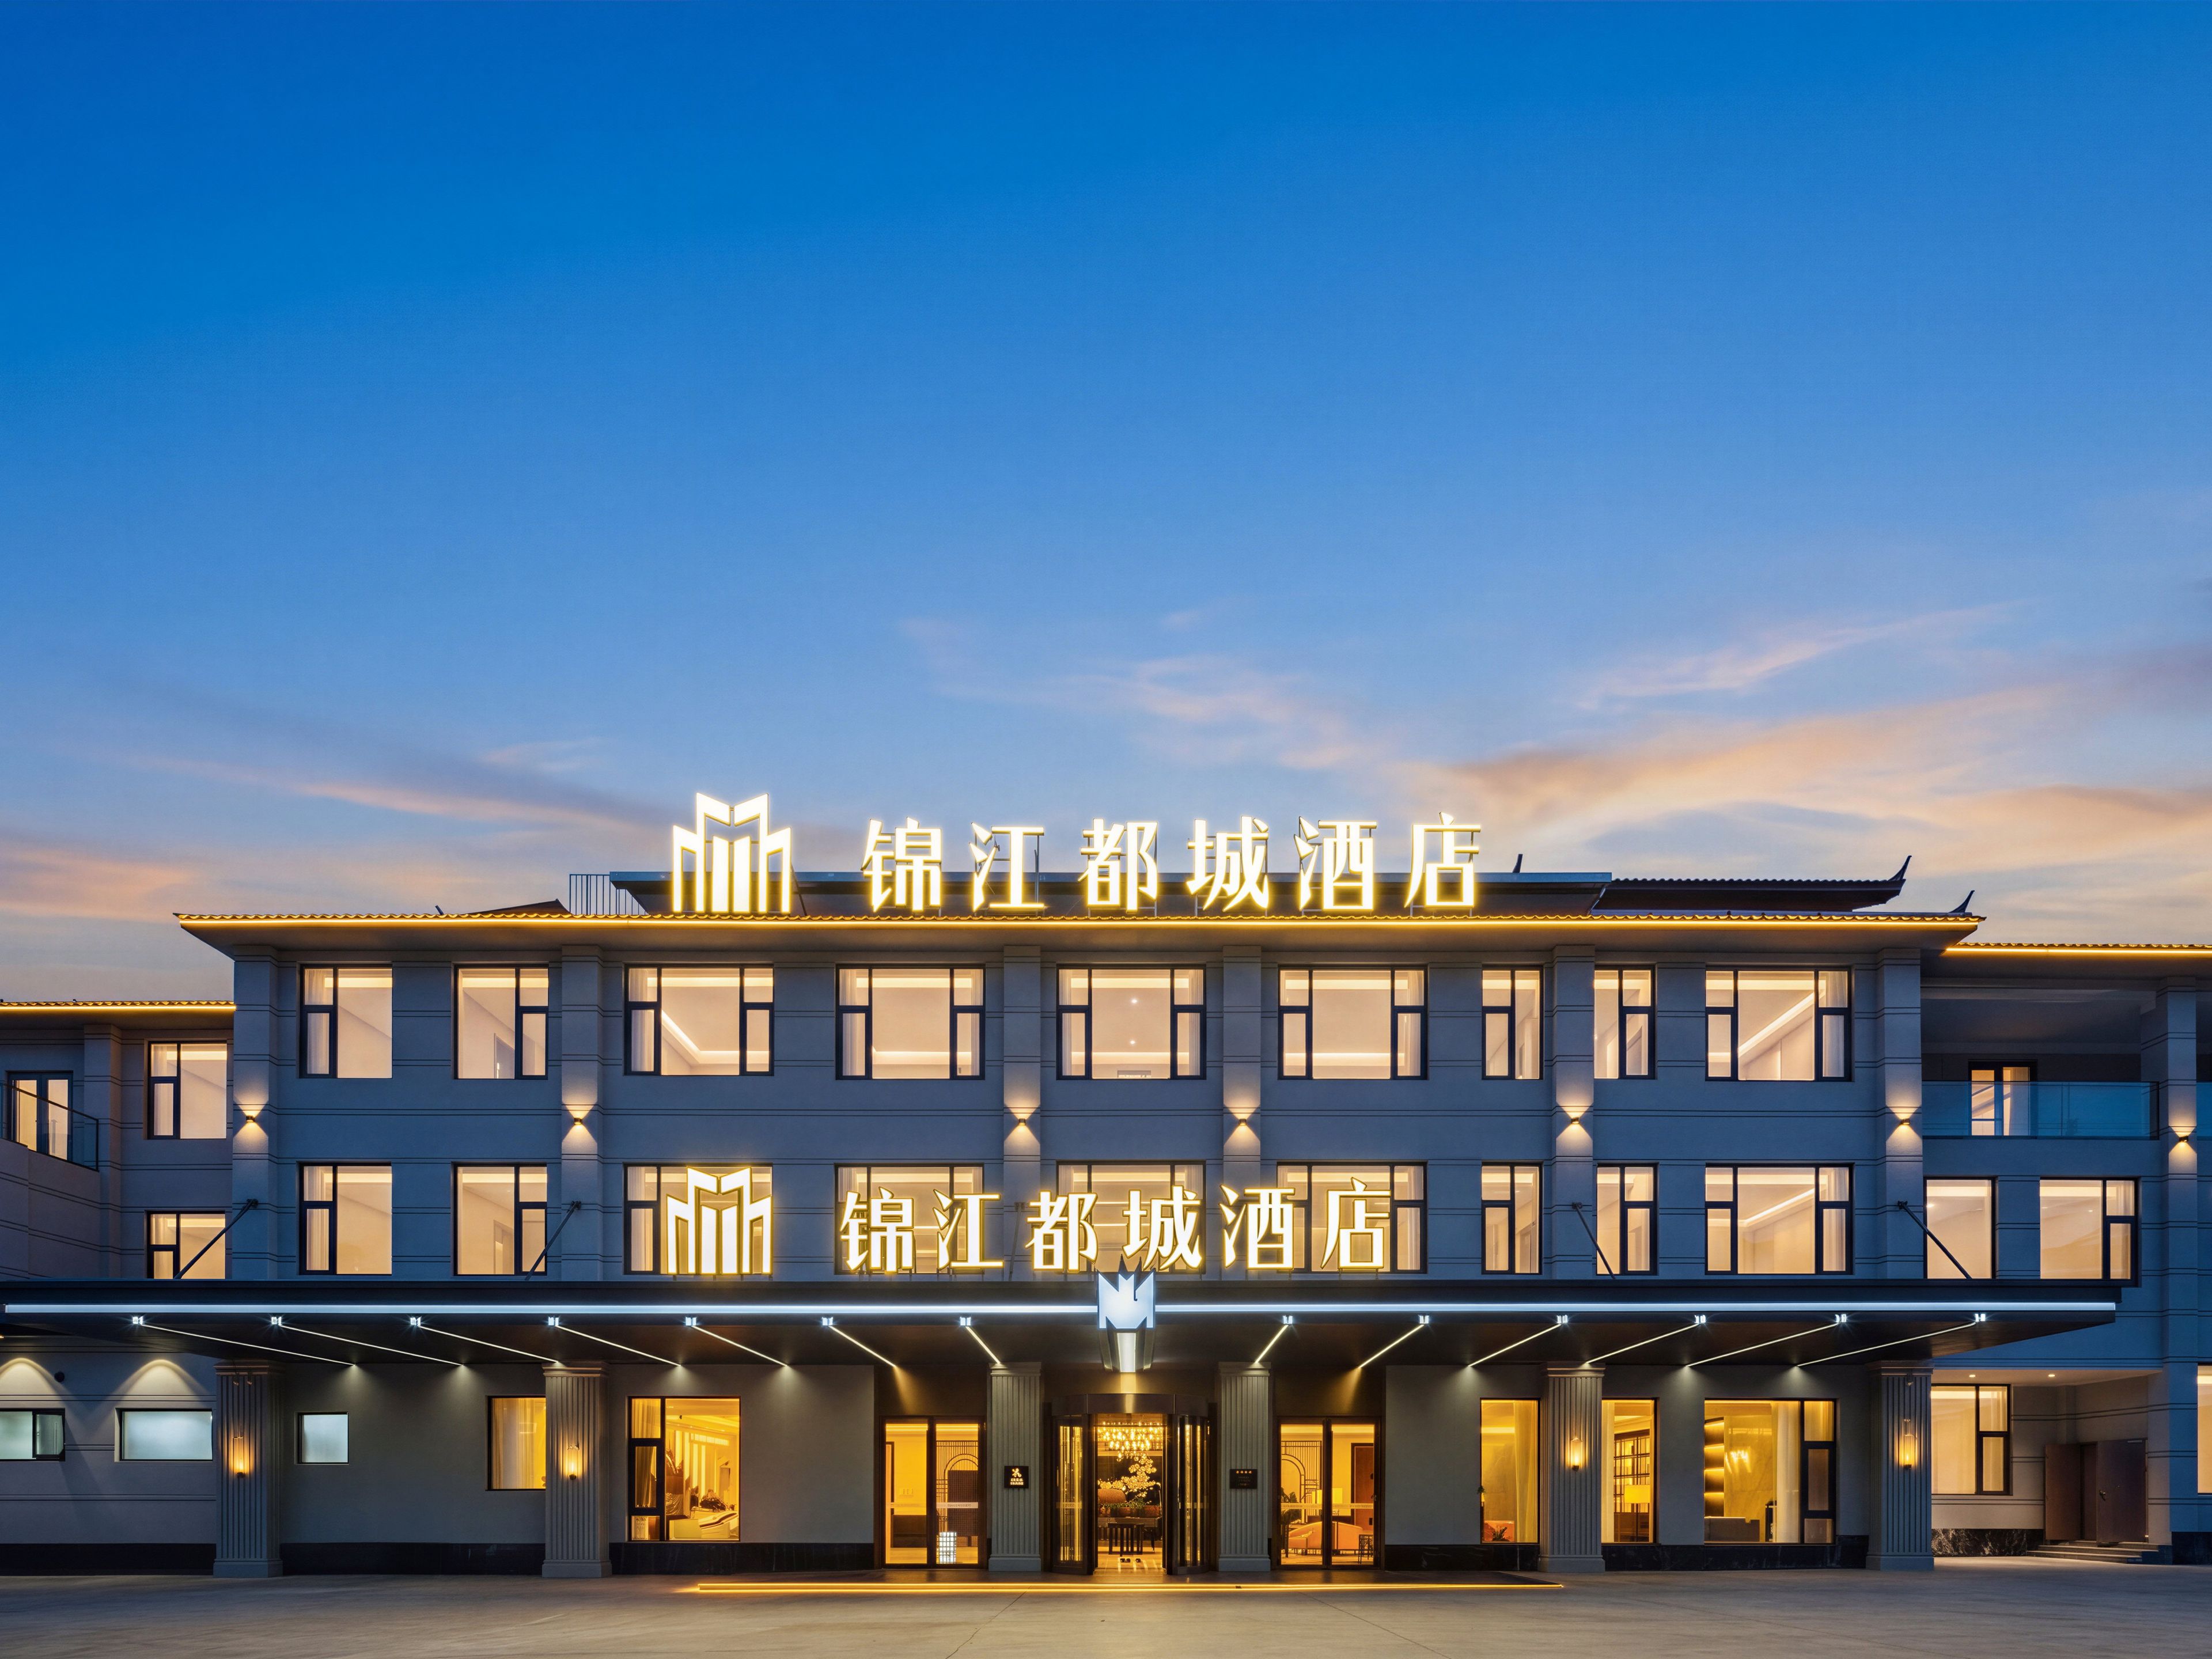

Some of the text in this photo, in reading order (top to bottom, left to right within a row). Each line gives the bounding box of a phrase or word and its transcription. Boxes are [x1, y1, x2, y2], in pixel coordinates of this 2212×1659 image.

[861, 812, 1482, 912] 锦江都城酒店
[840, 1177, 1392, 1272] 锦江都城酒店
